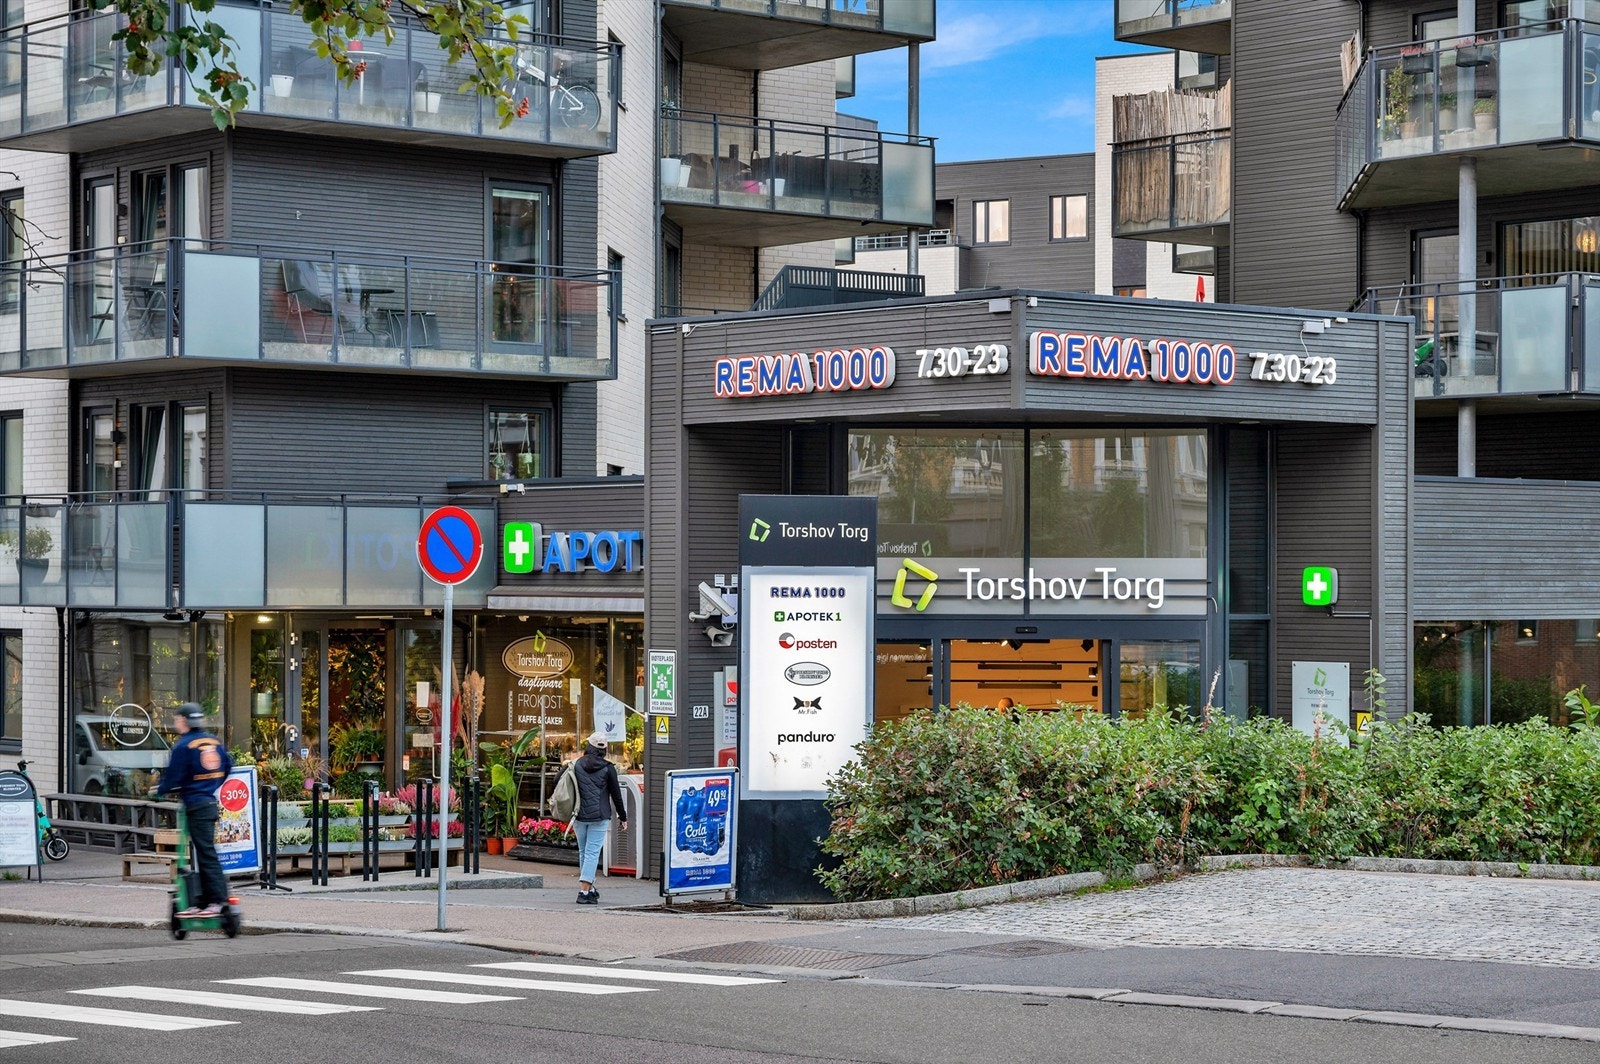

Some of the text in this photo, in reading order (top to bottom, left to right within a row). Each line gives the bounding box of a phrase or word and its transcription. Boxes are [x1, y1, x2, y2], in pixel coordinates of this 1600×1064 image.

[915, 344, 1005, 378] 7.30-23
[1034, 331, 1236, 385] REMA 1000
[714, 346, 890, 398] REMA 1000
[1250, 352, 1337, 385] 7.30-23
[779, 522, 869, 542] Torshov Torg
[542, 531, 645, 573] APOT
[770, 586, 846, 598] REMA 1000
[958, 567, 1165, 609] Torshov Torg
[786, 612, 842, 622] APOTEK 1
[796, 638, 837, 651] posten
[517, 653, 563, 671] Torshov Torg
[518, 675, 563, 692] dagligvare
[518, 715, 537, 725] KAFFE
[694, 706, 708, 717] 22A
[777, 731, 836, 745] panduro
[221, 789, 248, 801] -30%
[707, 789, 720, 807] 49
[685, 823, 708, 838] Cola
